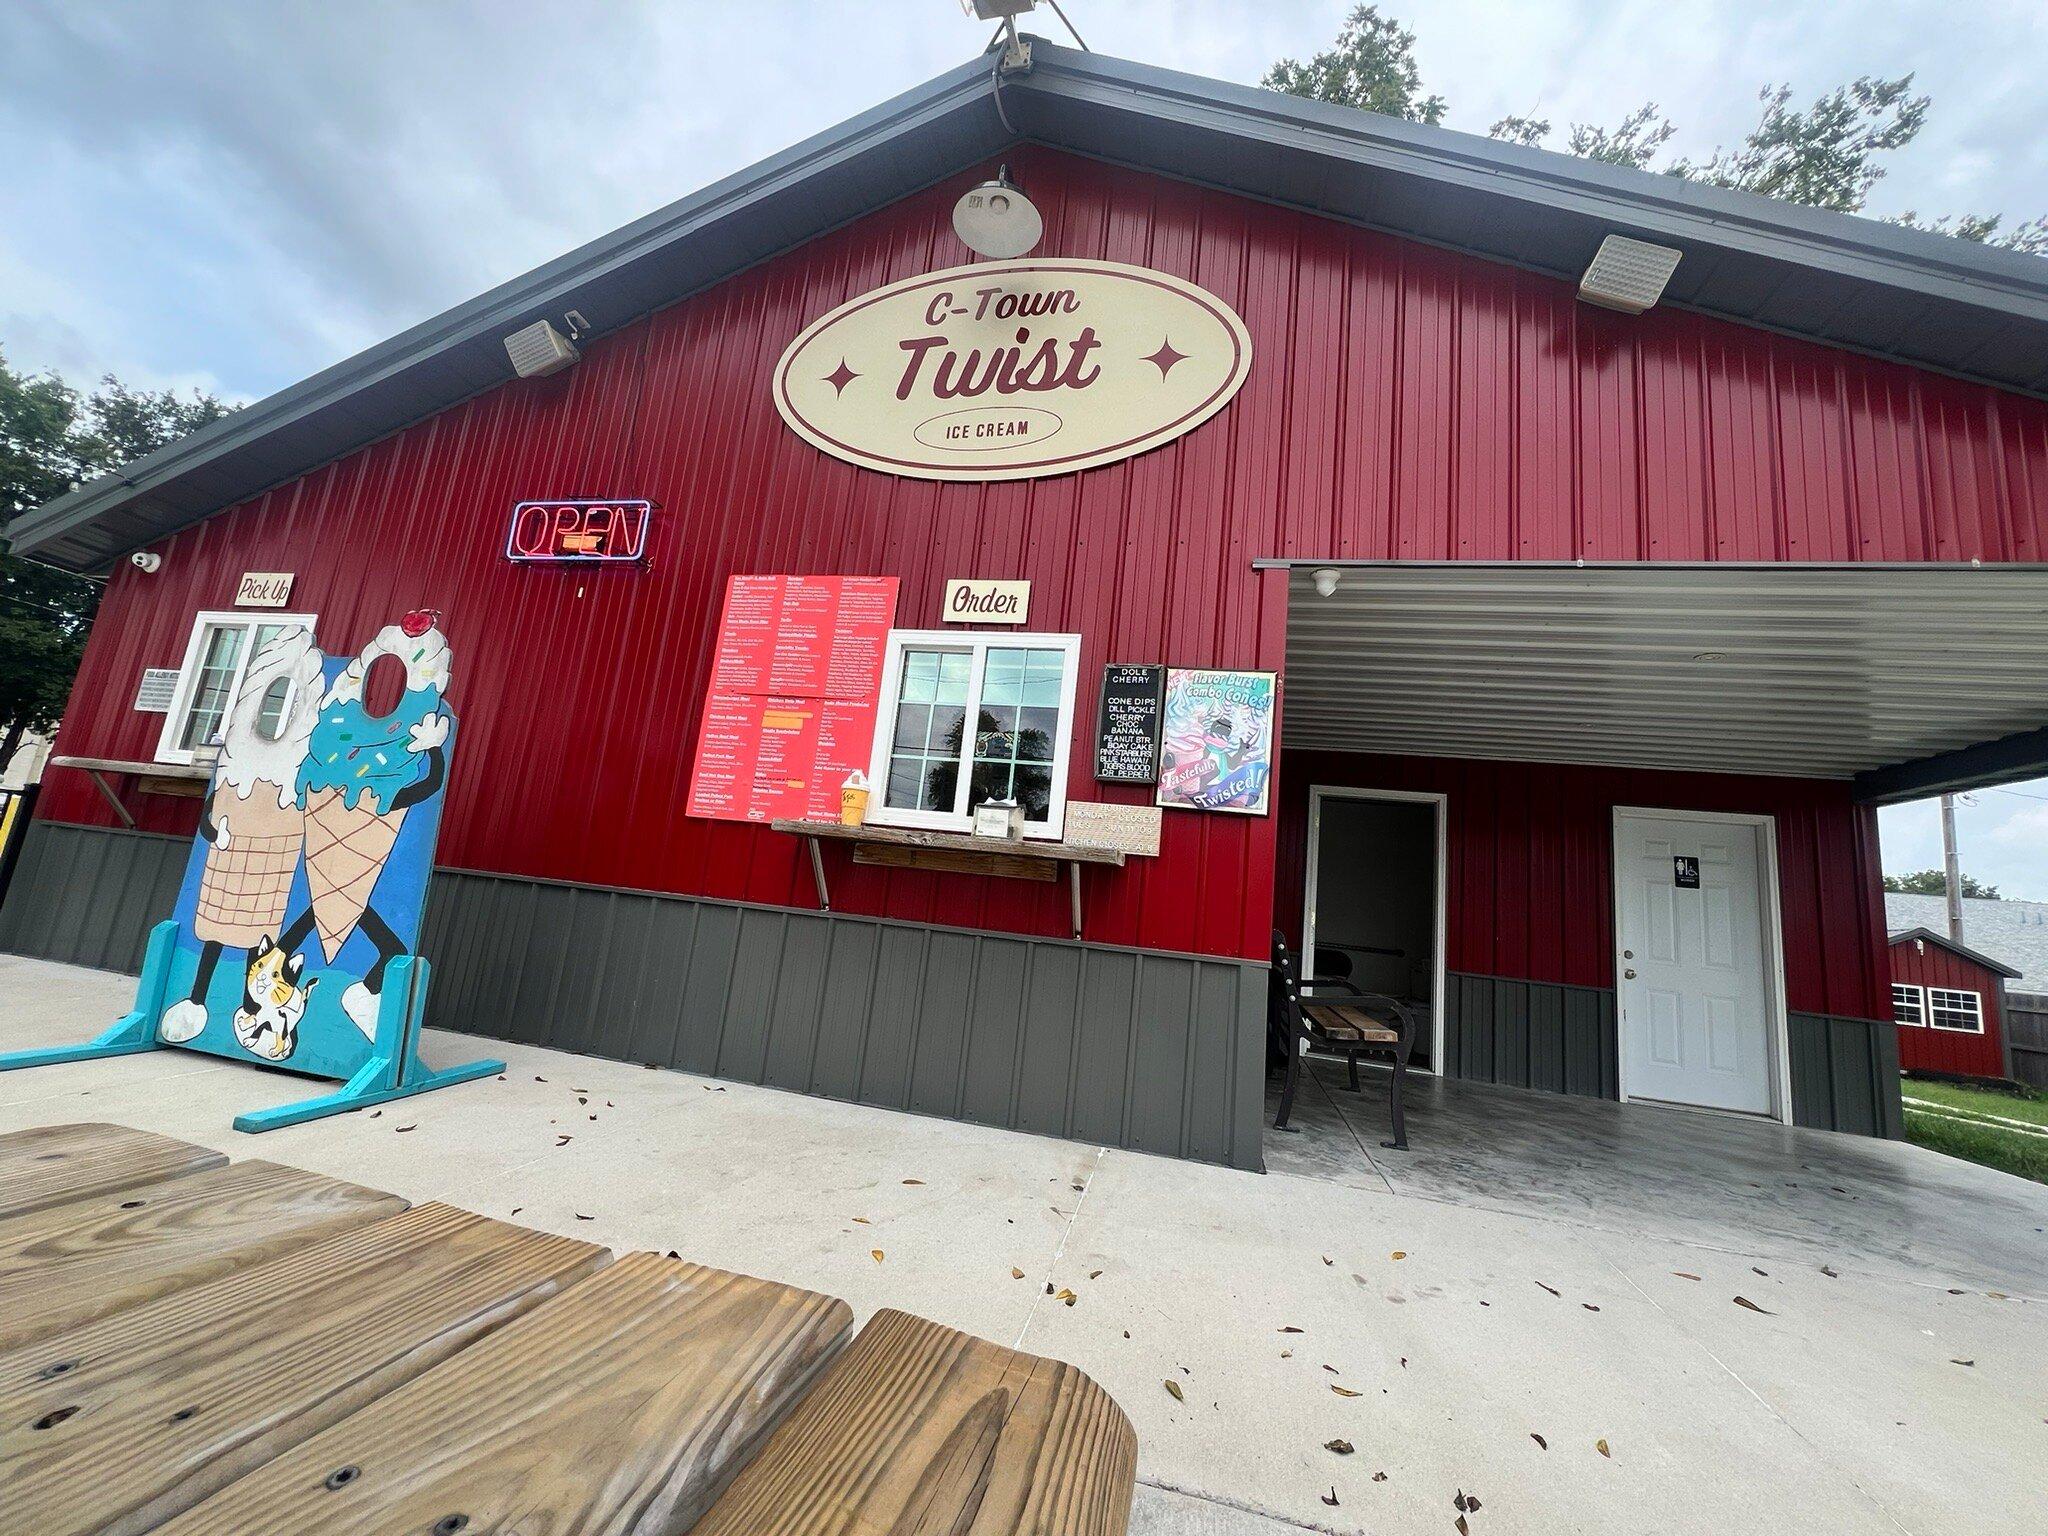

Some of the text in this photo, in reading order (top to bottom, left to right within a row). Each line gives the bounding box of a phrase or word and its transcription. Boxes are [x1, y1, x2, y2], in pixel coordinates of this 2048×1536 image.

[925, 287, 1081, 326] C-Town
[895, 326, 1102, 400] Twist
[946, 421, 1029, 439] ICE CREAM
[516, 506, 648, 557] OPEN
[239, 578, 289, 604] Pick Up
[952, 585, 1018, 614] Order
[1121, 668, 1148, 676] DOLE
[1112, 676, 1150, 684] CHERRY
[1226, 673, 1259, 689] Burst
[1186, 685, 1223, 699] Combo
[1107, 697, 1156, 706] CONE DIPS
[1108, 705, 1155, 714] DILL PICKLE
[1109, 713, 1146, 722] CHERRY
[1116, 720, 1139, 728] CHOC
[1111, 727, 1144, 735] BANANA
[1103, 734, 1134, 743] PEANUT
[1130, 743, 1154, 751] CAKE
[1100, 755, 1118, 763] BLUE
[1126, 763, 1151, 772] BLOOD
[1117, 769, 1150, 778] PEPPER
[1161, 760, 1217, 788] Tastefully
[1193, 769, 1264, 808] Twisted!
[1074, 810, 1109, 820] MONDAY
[1118, 813, 1156, 824] CLOSED
[1063, 837, 1097, 846] KITCHEN
[1099, 840, 1129, 850] CLOSES
